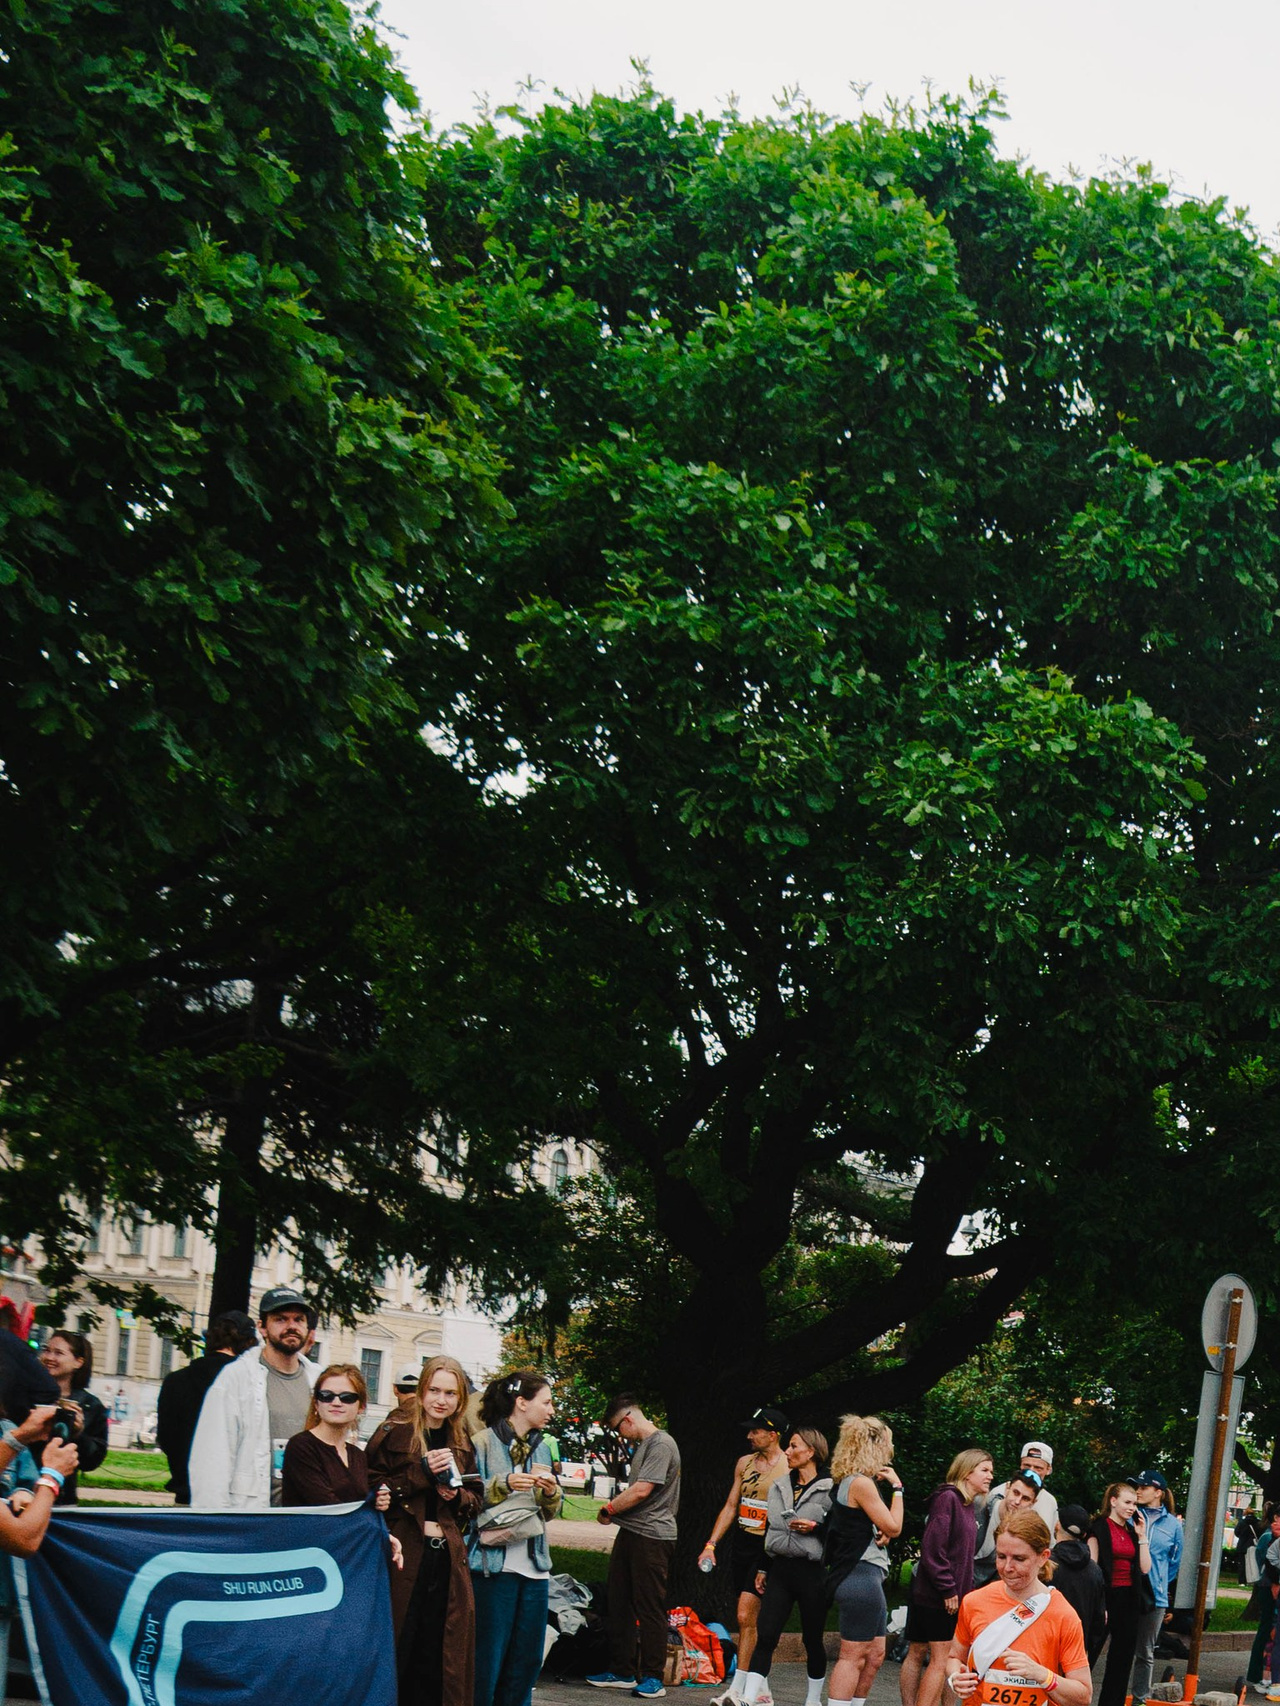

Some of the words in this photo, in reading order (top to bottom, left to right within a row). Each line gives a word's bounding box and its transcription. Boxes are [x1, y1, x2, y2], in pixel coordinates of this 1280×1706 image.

[748, 1509, 766, 1521] 10-2
[223, 1581, 246, 1595] SHU
[246, 1581, 273, 1594] RUN
[273, 1577, 304, 1592] CLUB
[989, 1687, 1037, 1706] 267-2
